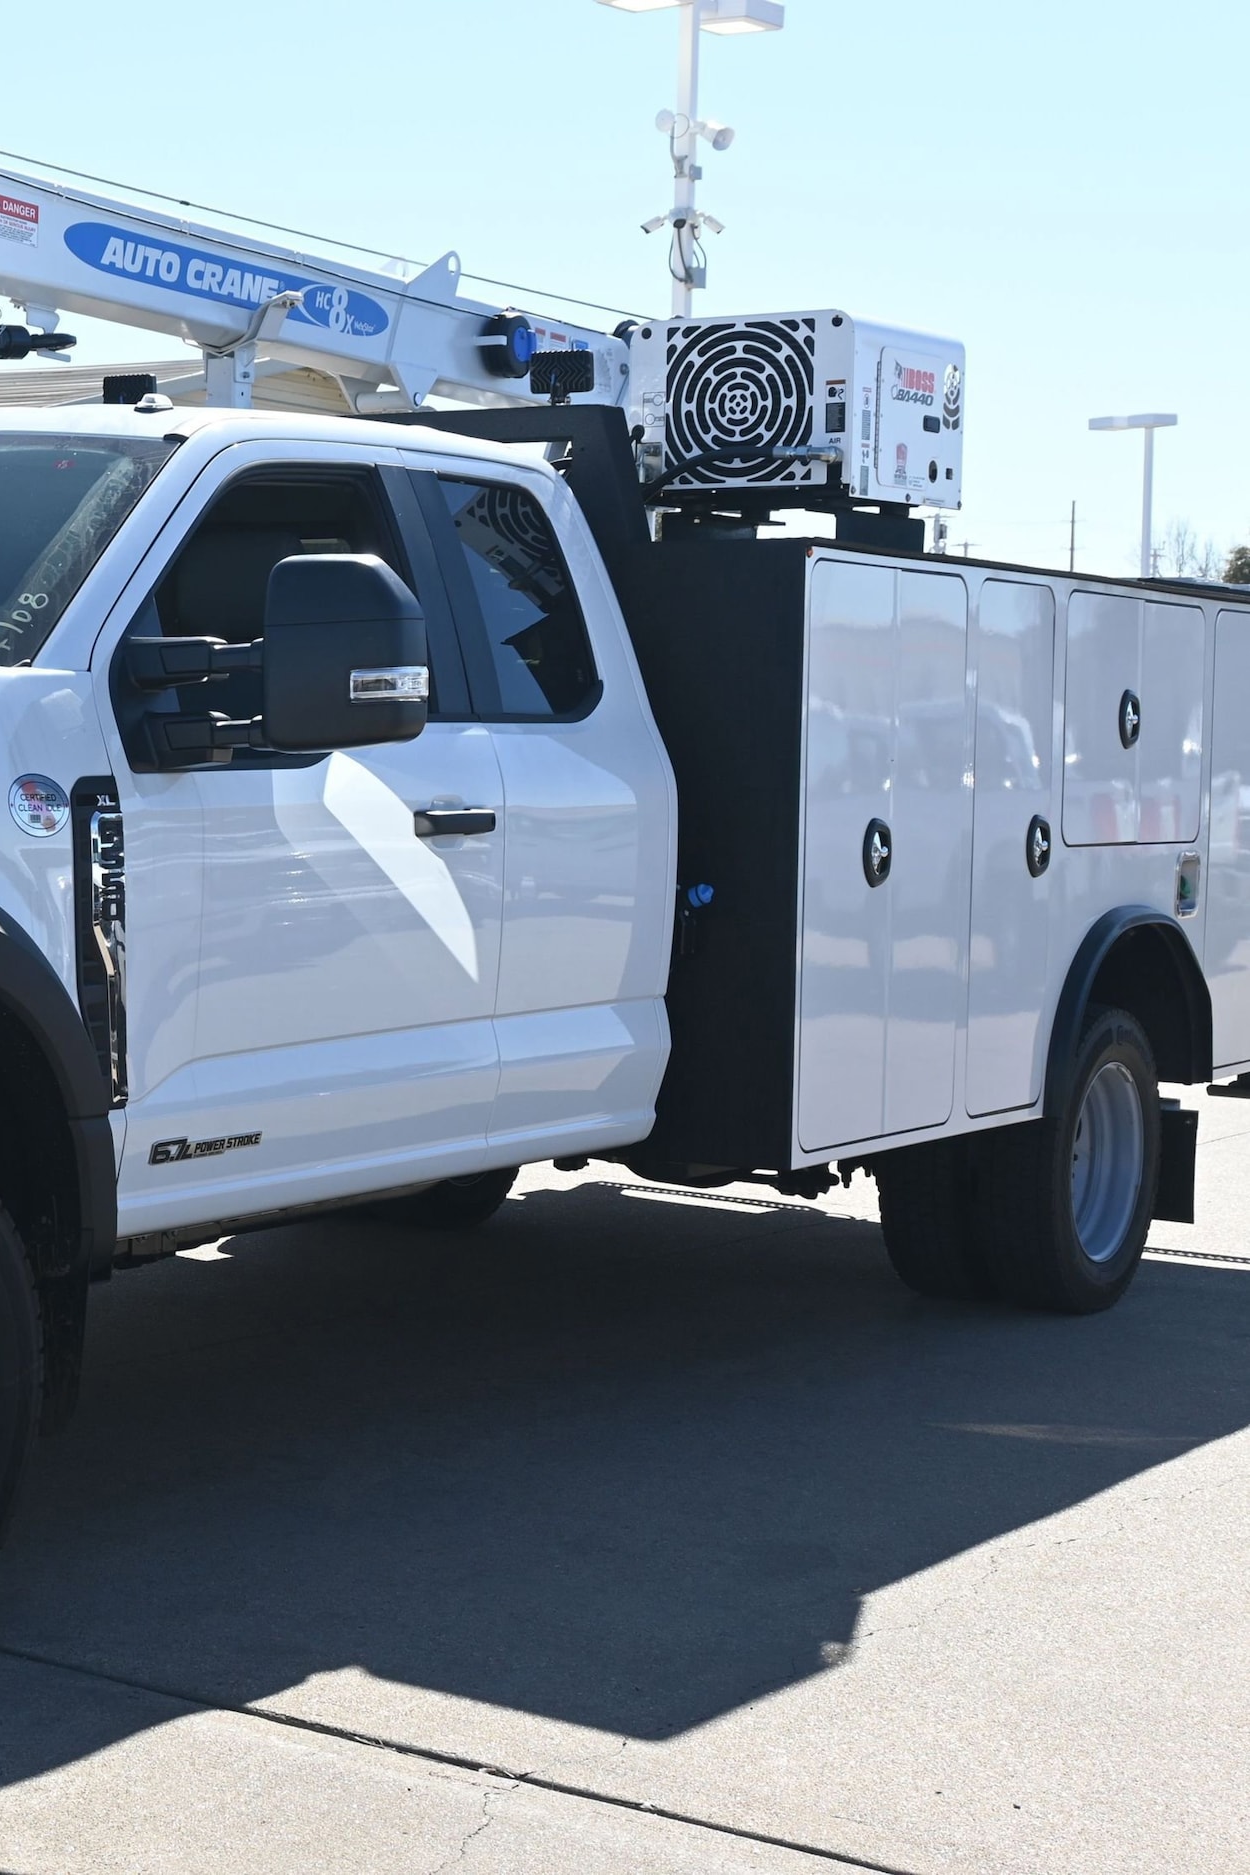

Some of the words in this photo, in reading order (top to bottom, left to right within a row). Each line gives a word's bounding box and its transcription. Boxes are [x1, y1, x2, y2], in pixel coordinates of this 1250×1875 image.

[2, 200, 36, 219] DANGER
[100, 236, 181, 283] AUTO
[186, 258, 279, 304] CRANE
[908, 367, 935, 394] BOSS
[20, 793, 57, 802] CERTIFIED
[96, 794, 116, 806] XL
[18, 803, 43, 812] CLEAN
[194, 1139, 225, 1154] POWER
[226, 1133, 261, 1148] STROKE
